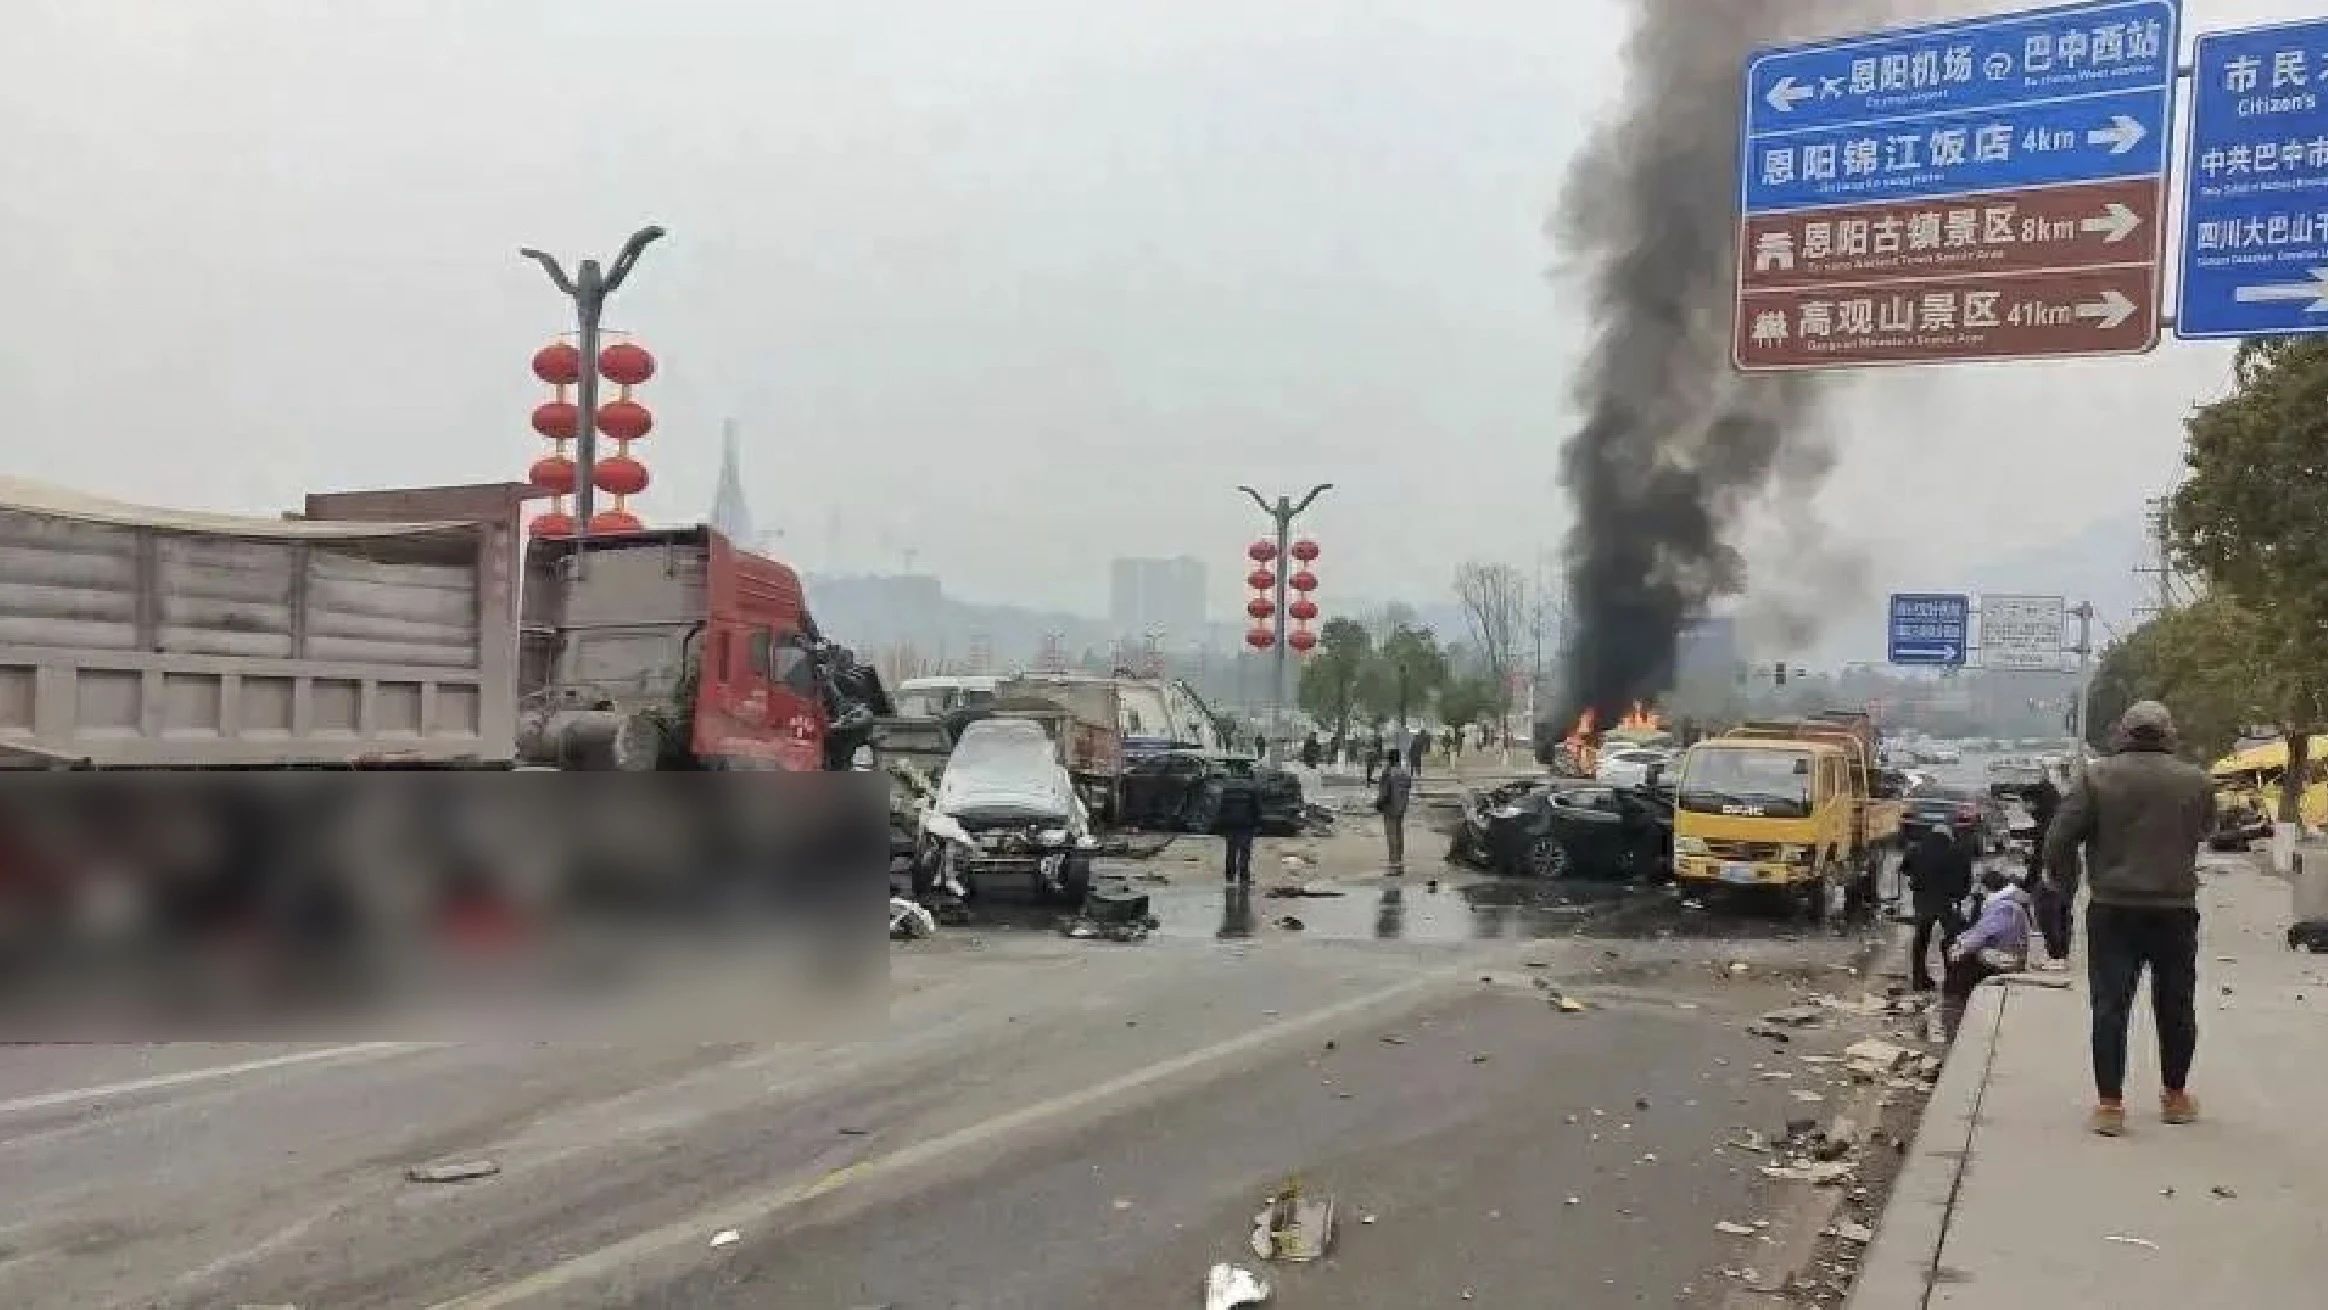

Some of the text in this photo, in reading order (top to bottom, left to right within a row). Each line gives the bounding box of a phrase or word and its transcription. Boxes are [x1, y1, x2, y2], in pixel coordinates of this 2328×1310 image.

[1850, 46, 1972, 94] 恩阳机场
[2025, 19, 2162, 73] 巴中西站
[1762, 125, 2014, 186] 恩阳锦江饭店
[2021, 125, 2074, 153] 4km
[1802, 206, 2074, 258] 恩阳古镇景区 8km
[1800, 291, 2071, 338] 高观山景区 41km
